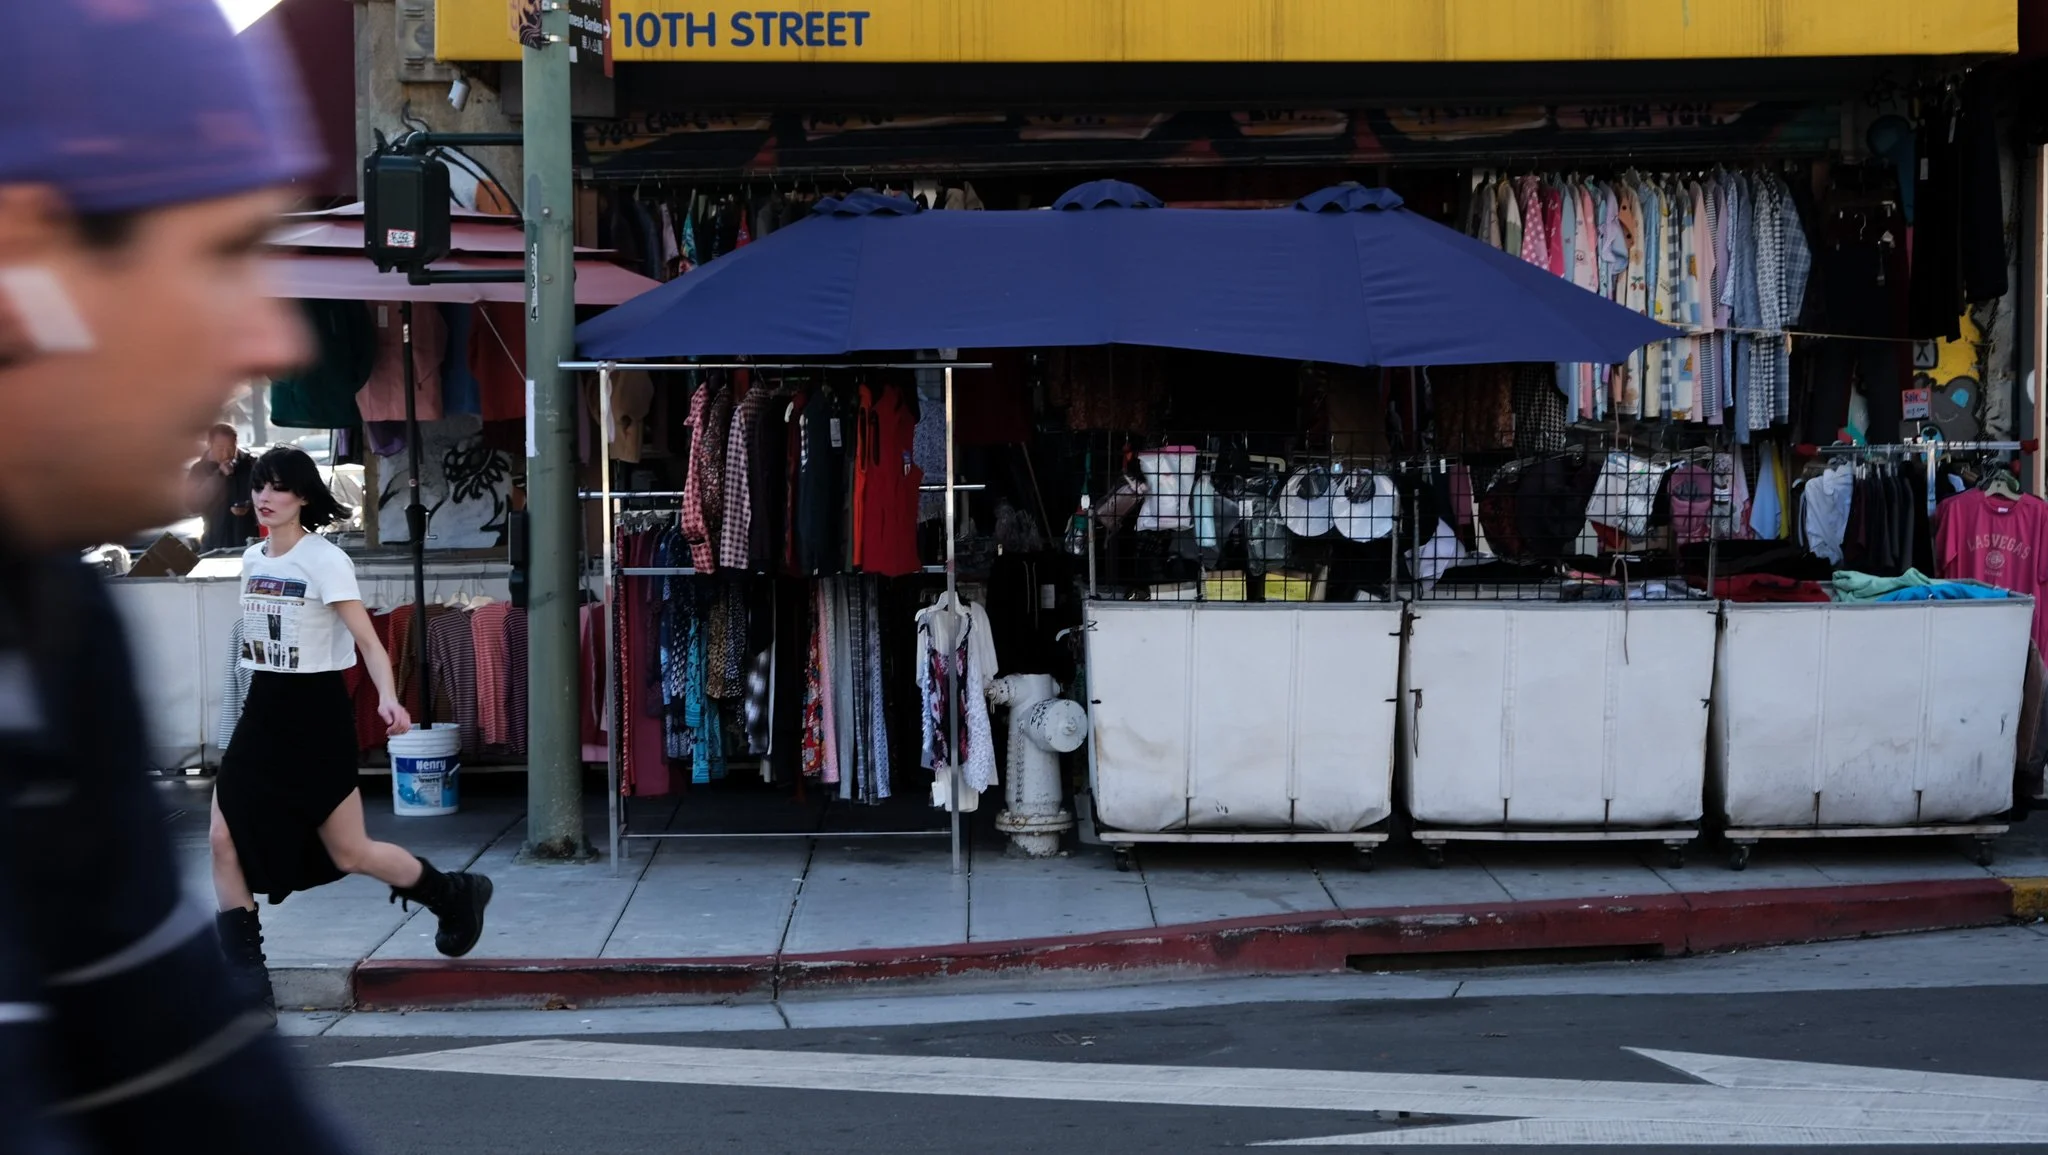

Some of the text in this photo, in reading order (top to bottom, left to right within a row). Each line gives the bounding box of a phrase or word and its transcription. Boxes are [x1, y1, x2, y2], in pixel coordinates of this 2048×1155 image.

[617, 11, 870, 48] 10TH STREET
[1581, 104, 1650, 127] WITH
[595, 121, 638, 146] YOU
[1904, 391, 1919, 403] Sale
[1991, 533, 2032, 560] VEGAS
[416, 759, 446, 771] Henry
